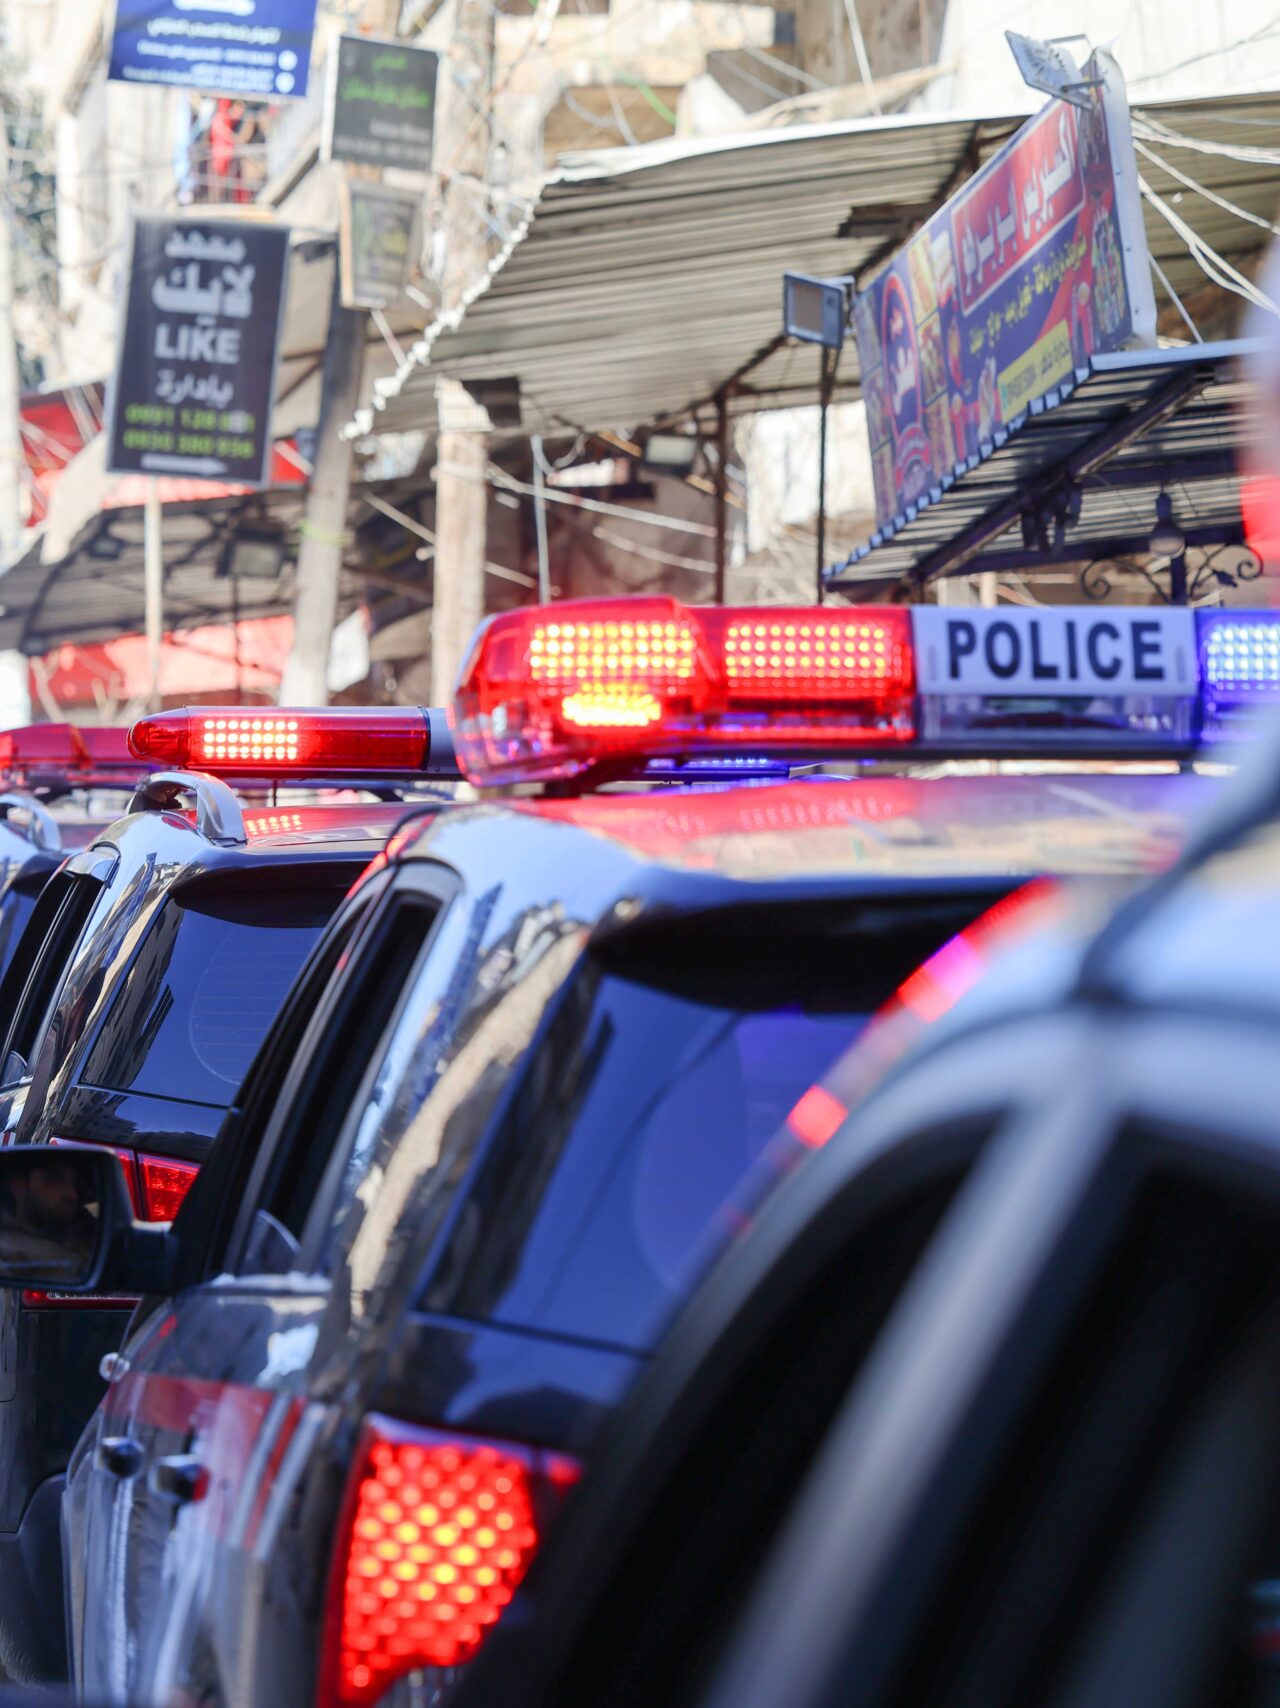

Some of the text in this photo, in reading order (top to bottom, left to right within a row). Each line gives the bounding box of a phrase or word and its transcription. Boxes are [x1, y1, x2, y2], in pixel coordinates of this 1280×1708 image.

[152, 263, 255, 326] لايك
[155, 323, 240, 364] LIKE
[947, 620, 1165, 681] POLICE
